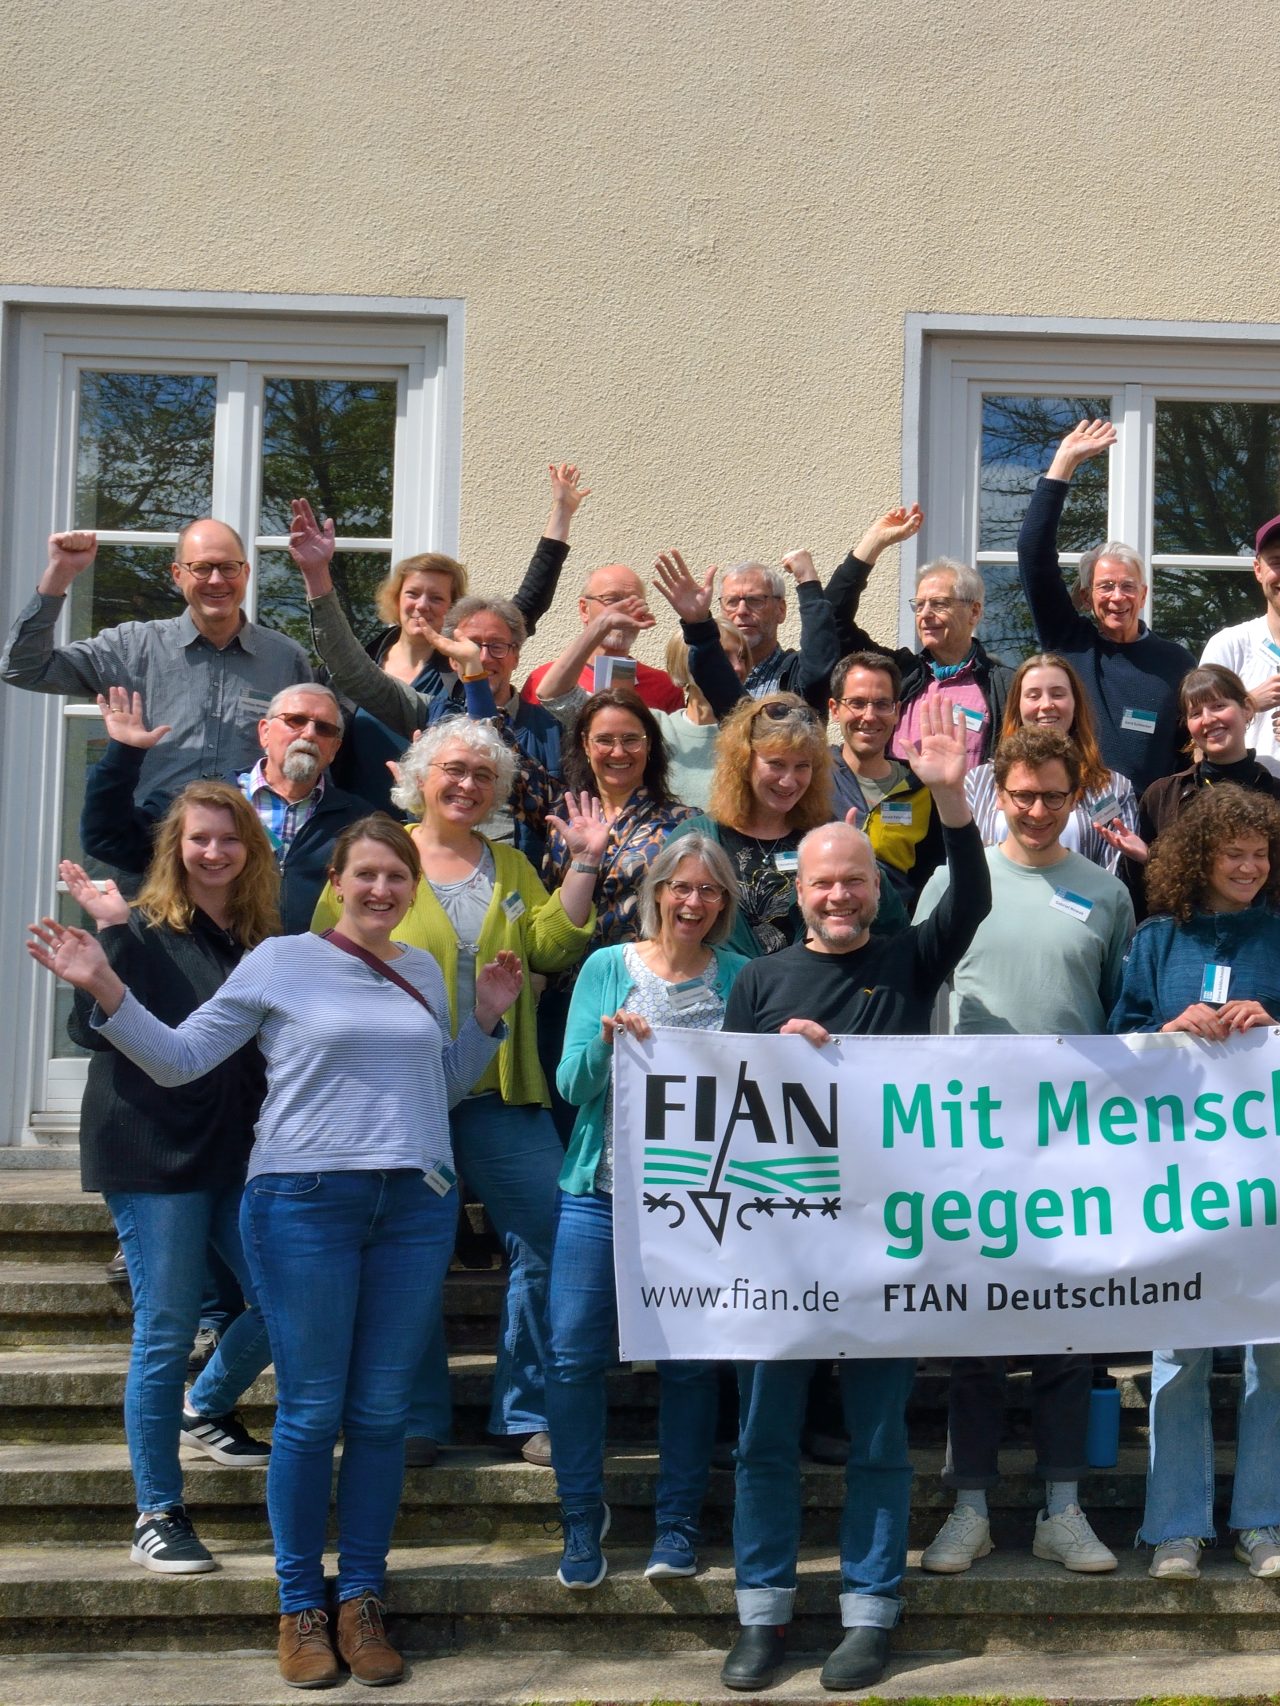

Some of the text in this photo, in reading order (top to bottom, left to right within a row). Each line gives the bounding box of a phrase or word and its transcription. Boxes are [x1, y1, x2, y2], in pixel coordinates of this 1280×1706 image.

[645, 1064, 838, 1148] FIAN
[882, 1079, 1002, 1149] Mit
[883, 1183, 1112, 1259] gegen
[1143, 1164, 1277, 1234] den
[641, 1278, 839, 1312] www.fian.de
[884, 1272, 1202, 1312] FIAN Deutschland
